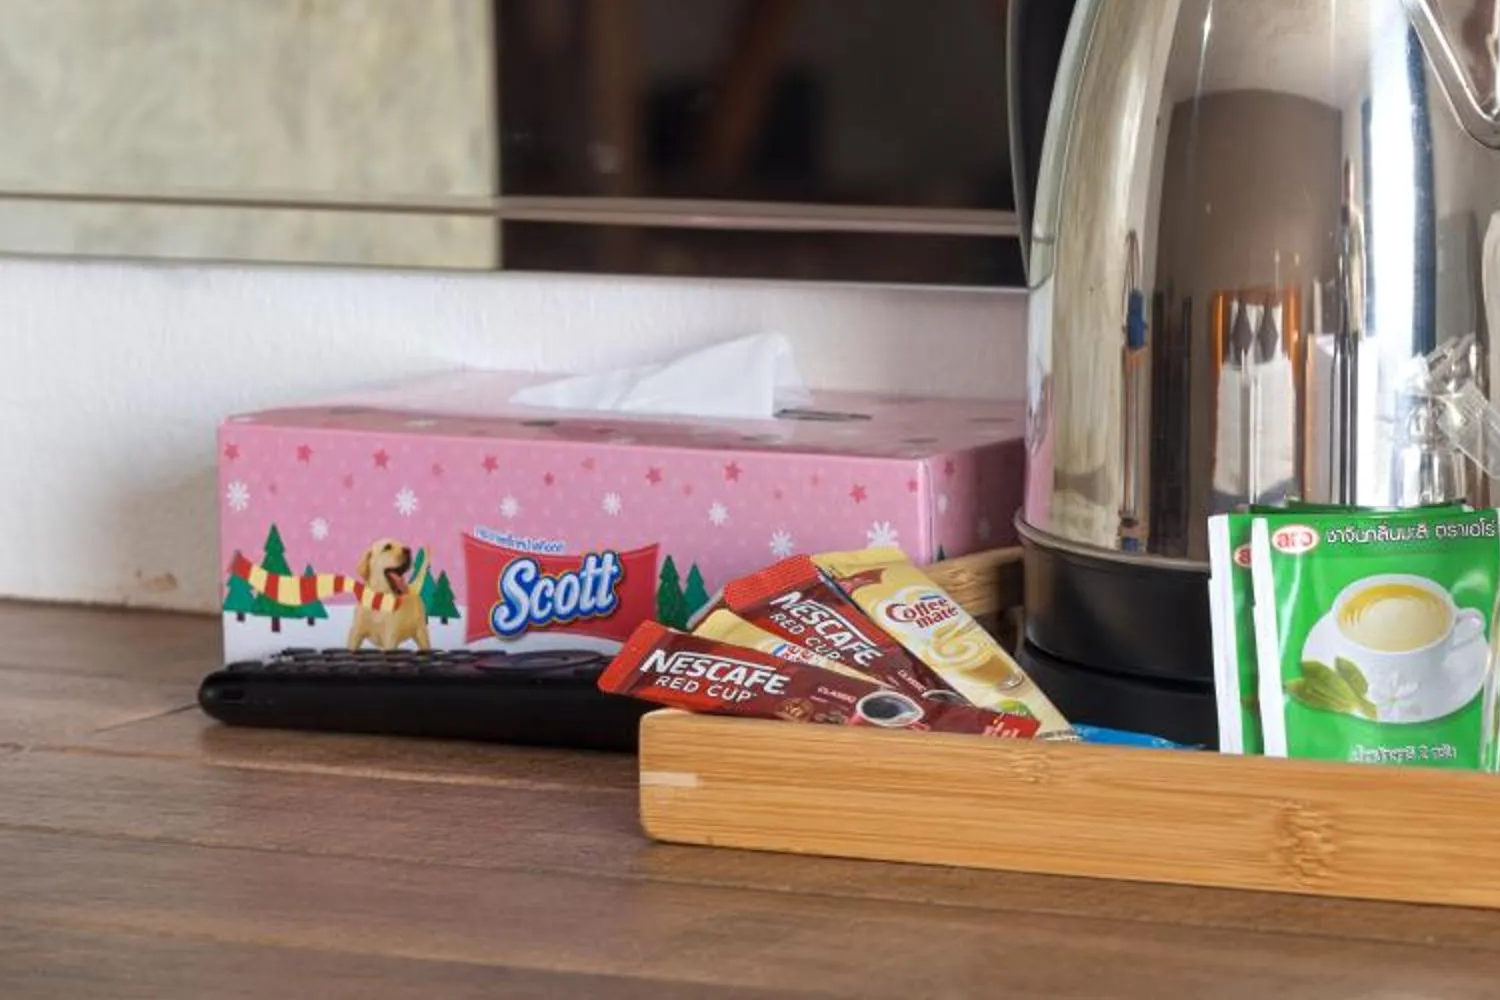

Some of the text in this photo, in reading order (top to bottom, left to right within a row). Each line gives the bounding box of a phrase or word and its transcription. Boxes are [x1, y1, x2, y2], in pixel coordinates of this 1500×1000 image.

[491, 551, 621, 636] Scott
[769, 612, 806, 636] RED
[804, 636, 841, 661] CUP
[655, 675, 752, 703] RED CUP
